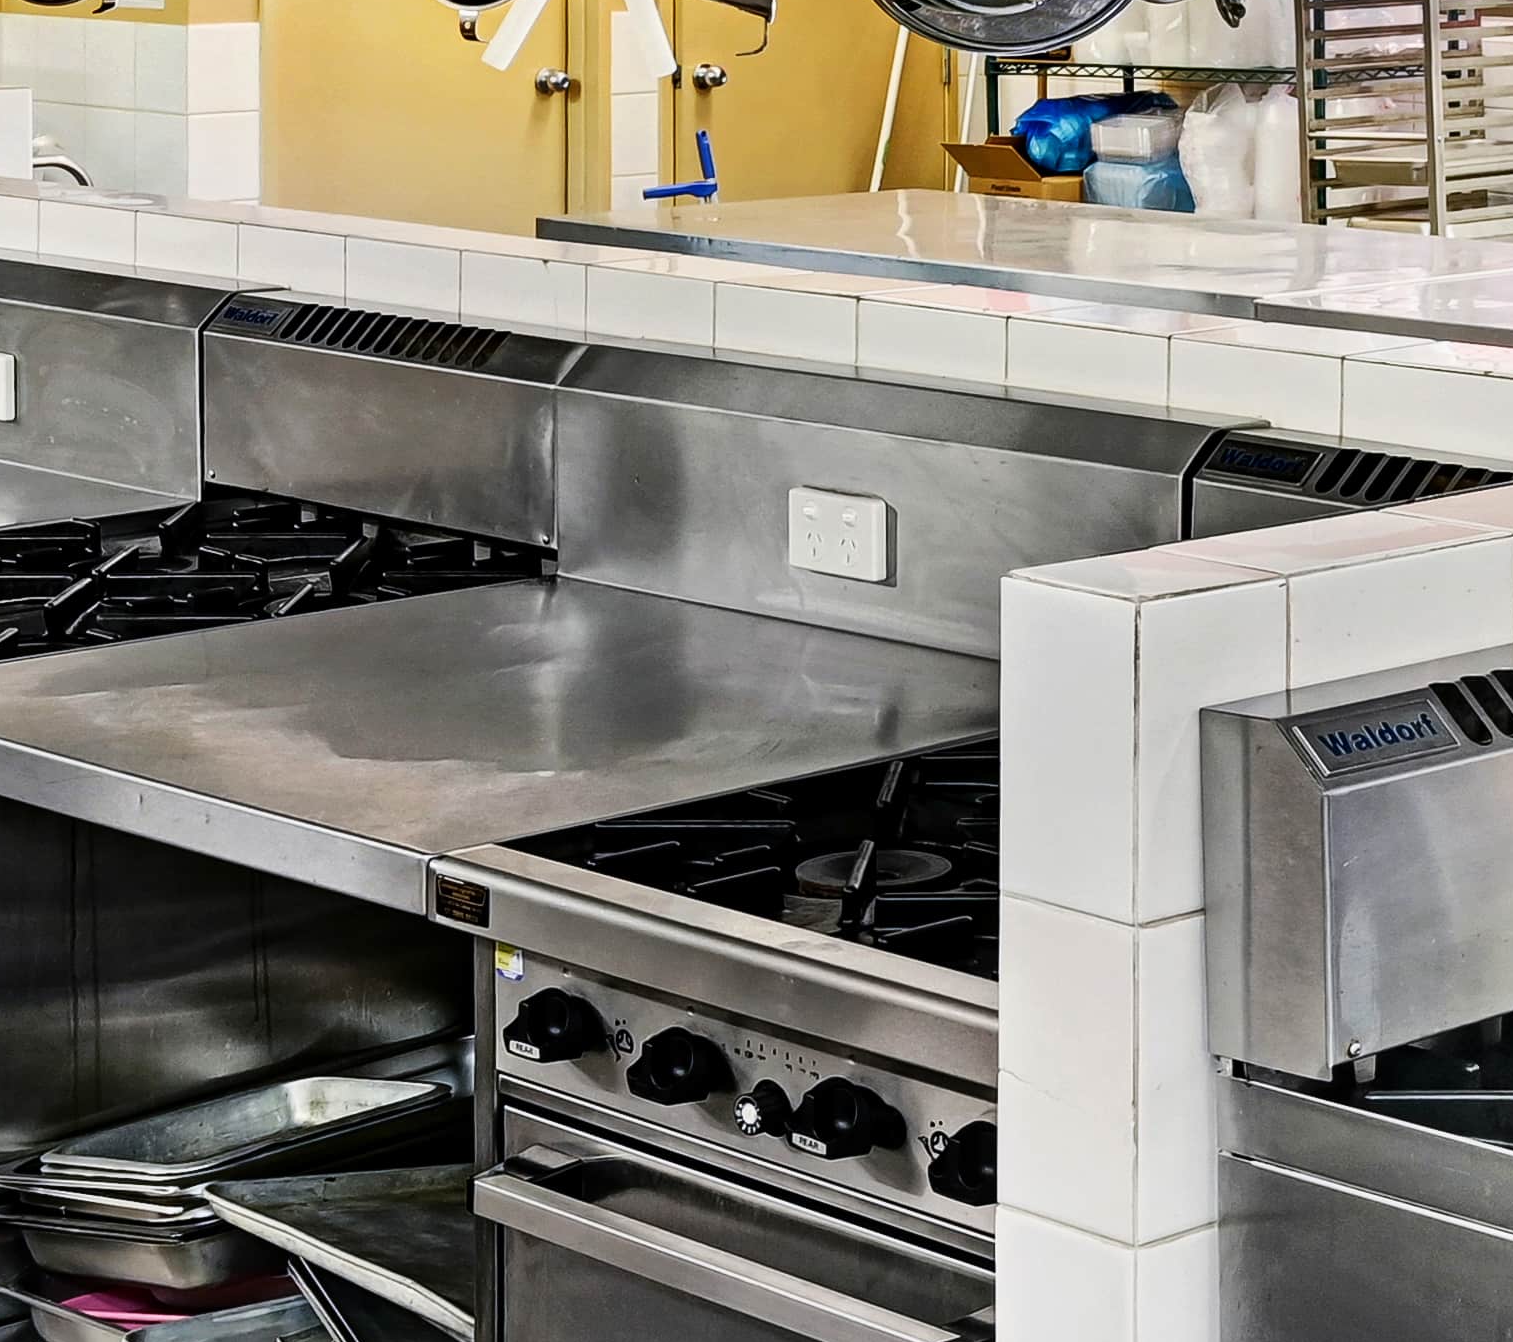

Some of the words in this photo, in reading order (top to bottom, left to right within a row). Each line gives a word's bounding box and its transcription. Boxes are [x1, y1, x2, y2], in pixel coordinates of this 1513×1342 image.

[223, 305, 280, 326] Waldorf
[1220, 447, 1307, 473] Waldorf
[1317, 713, 1438, 757] Waldorf
[799, 1137, 821, 1150] REAR
